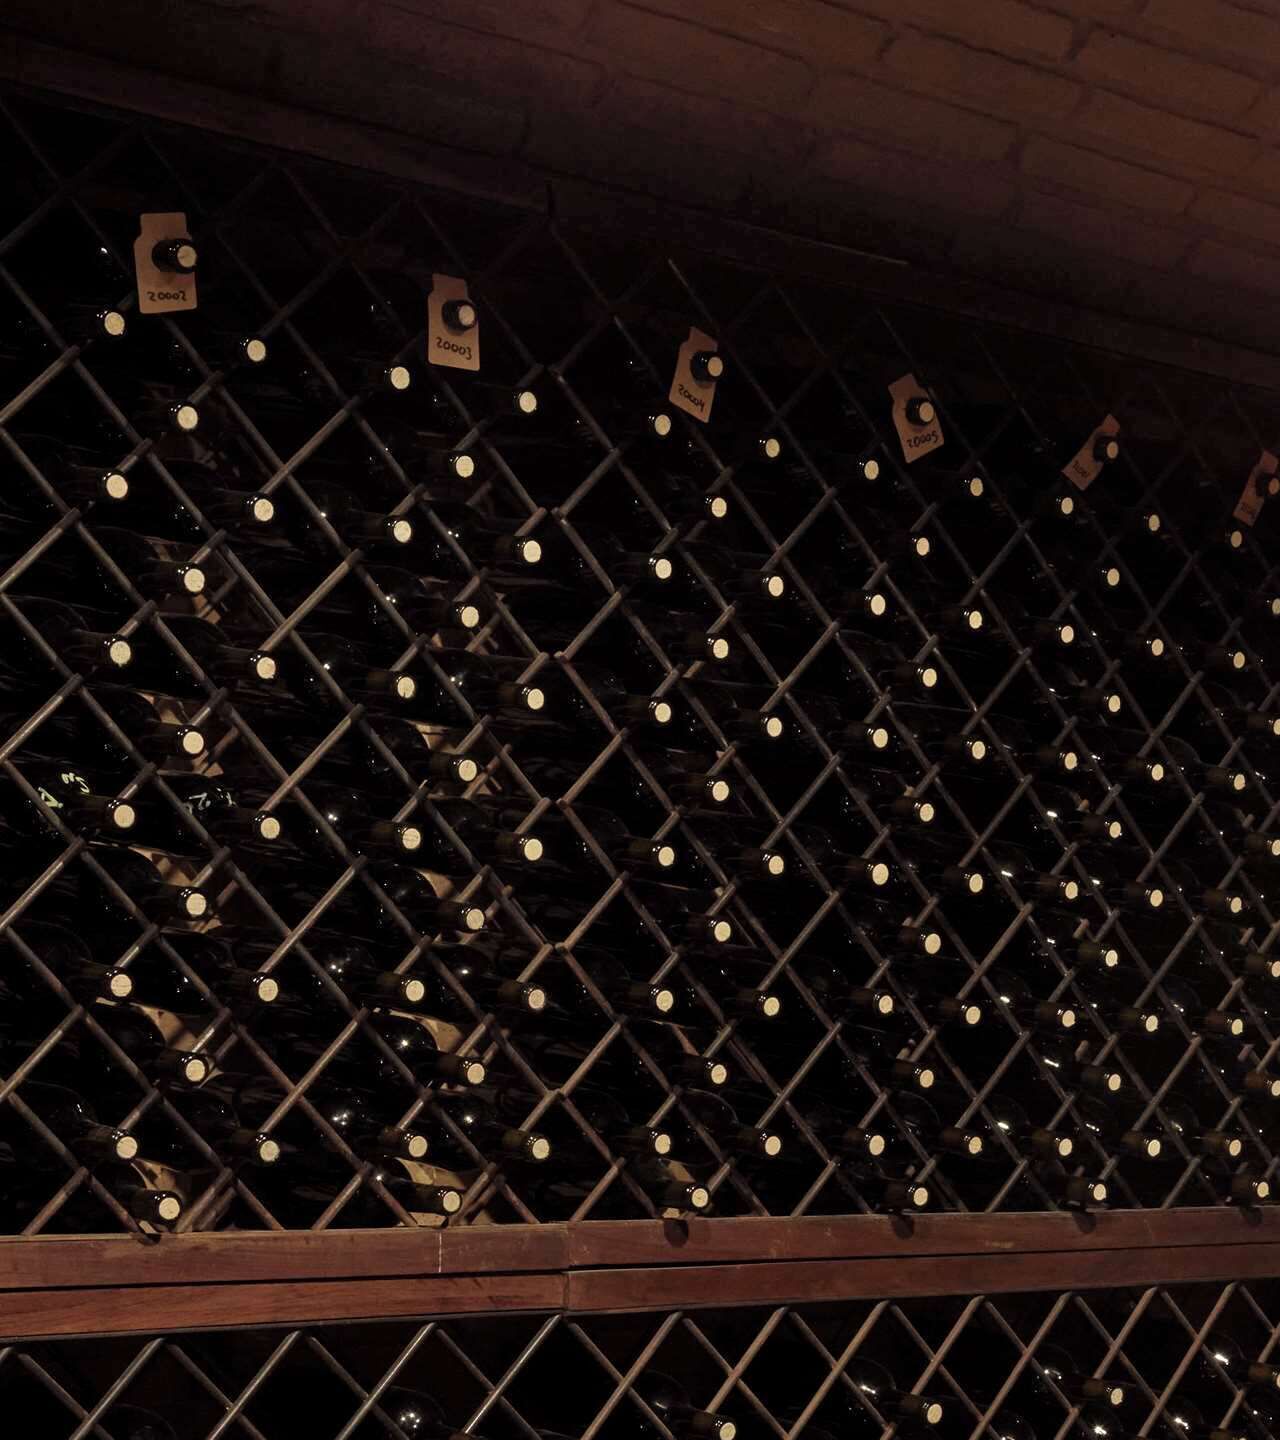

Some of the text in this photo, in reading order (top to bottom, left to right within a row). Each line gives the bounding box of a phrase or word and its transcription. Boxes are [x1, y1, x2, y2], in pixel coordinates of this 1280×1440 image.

[146, 289, 187, 302] 20002
[435, 336, 473, 361] 20003
[677, 383, 706, 413] 20004
[906, 430, 939, 449] 20005
